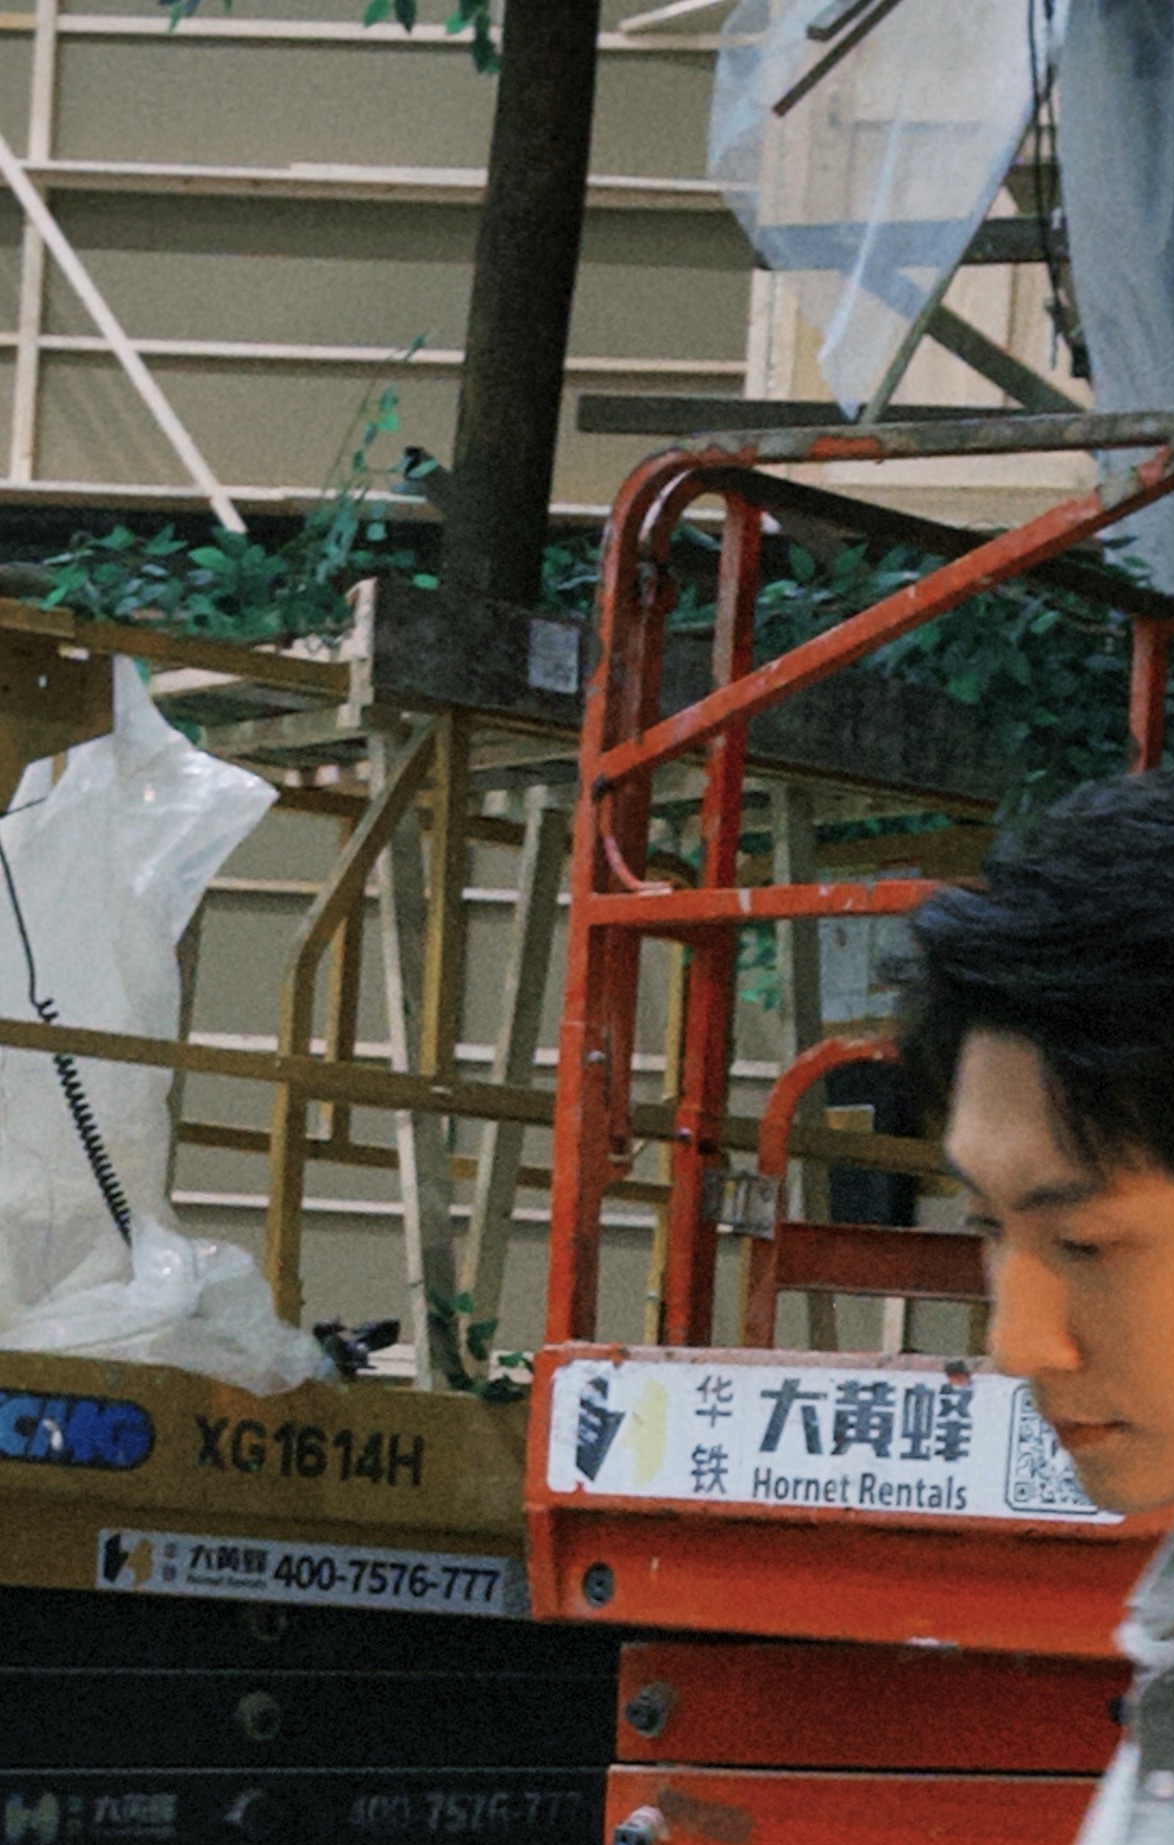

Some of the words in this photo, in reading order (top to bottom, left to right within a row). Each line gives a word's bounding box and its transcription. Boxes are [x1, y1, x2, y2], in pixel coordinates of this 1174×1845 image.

[0, 1393, 152, 1466] CMG
[195, 1413, 425, 1487] XG1614H
[691, 1375, 733, 1495] 华铁
[759, 1377, 974, 1461] 大黄蜂
[752, 1467, 850, 1503] Hornet
[859, 1471, 968, 1510] Rentals
[273, 1554, 500, 1601] 400-7576-777
